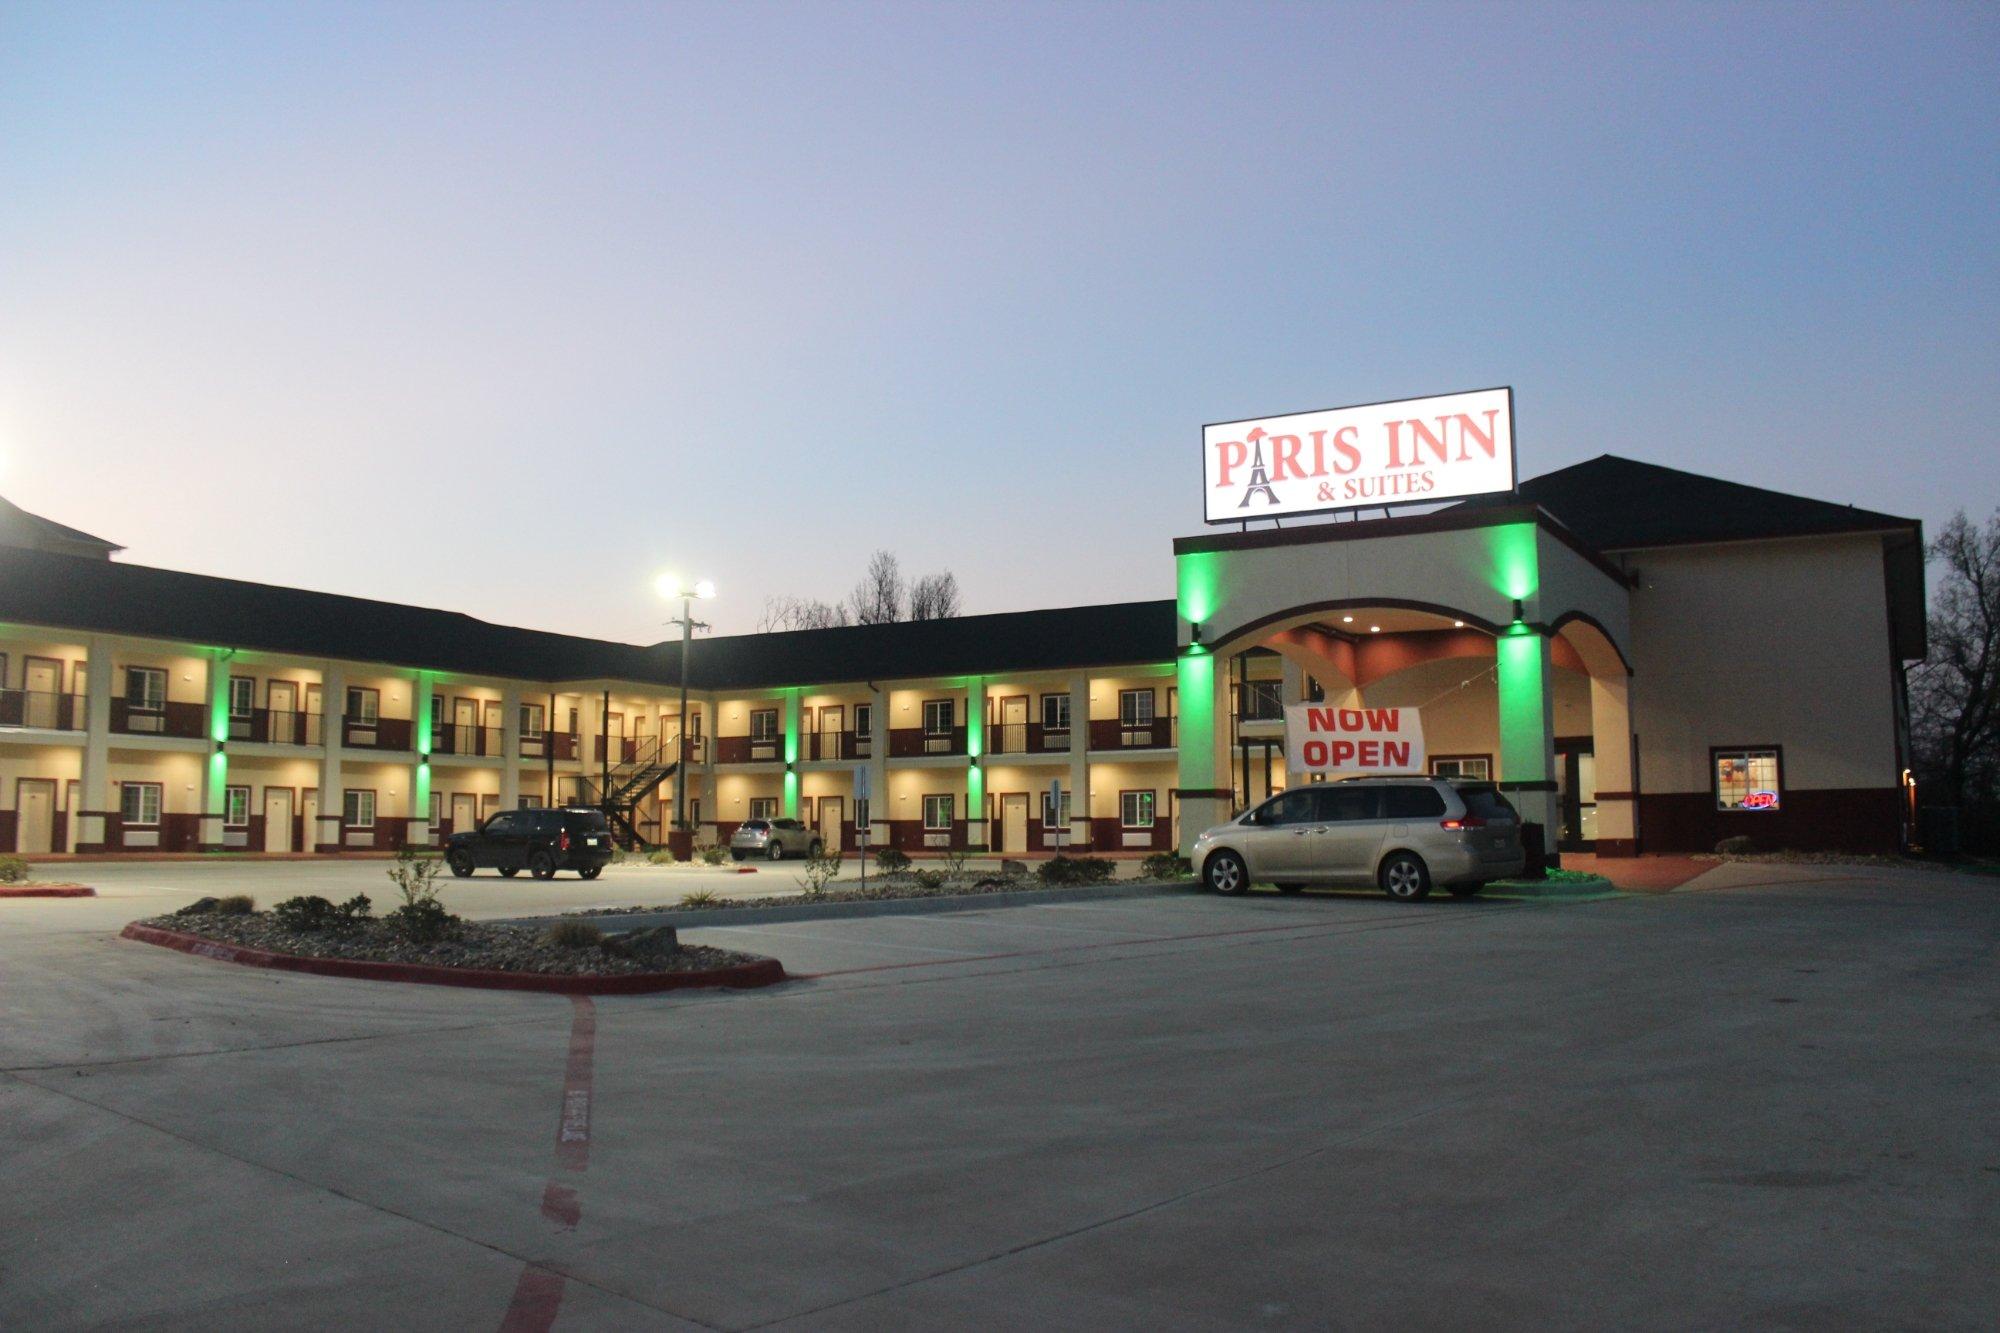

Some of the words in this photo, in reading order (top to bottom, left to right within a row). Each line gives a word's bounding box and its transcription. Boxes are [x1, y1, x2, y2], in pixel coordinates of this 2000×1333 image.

[1214, 425, 1362, 508] PARIS
[1383, 409, 1500, 469] INN
[1316, 481, 1336, 502] &
[1344, 471, 1435, 499] SUITES
[1307, 708, 1400, 732] NOW
[1303, 740, 1410, 767] OPEN
[1743, 793, 1773, 807] OPEN
